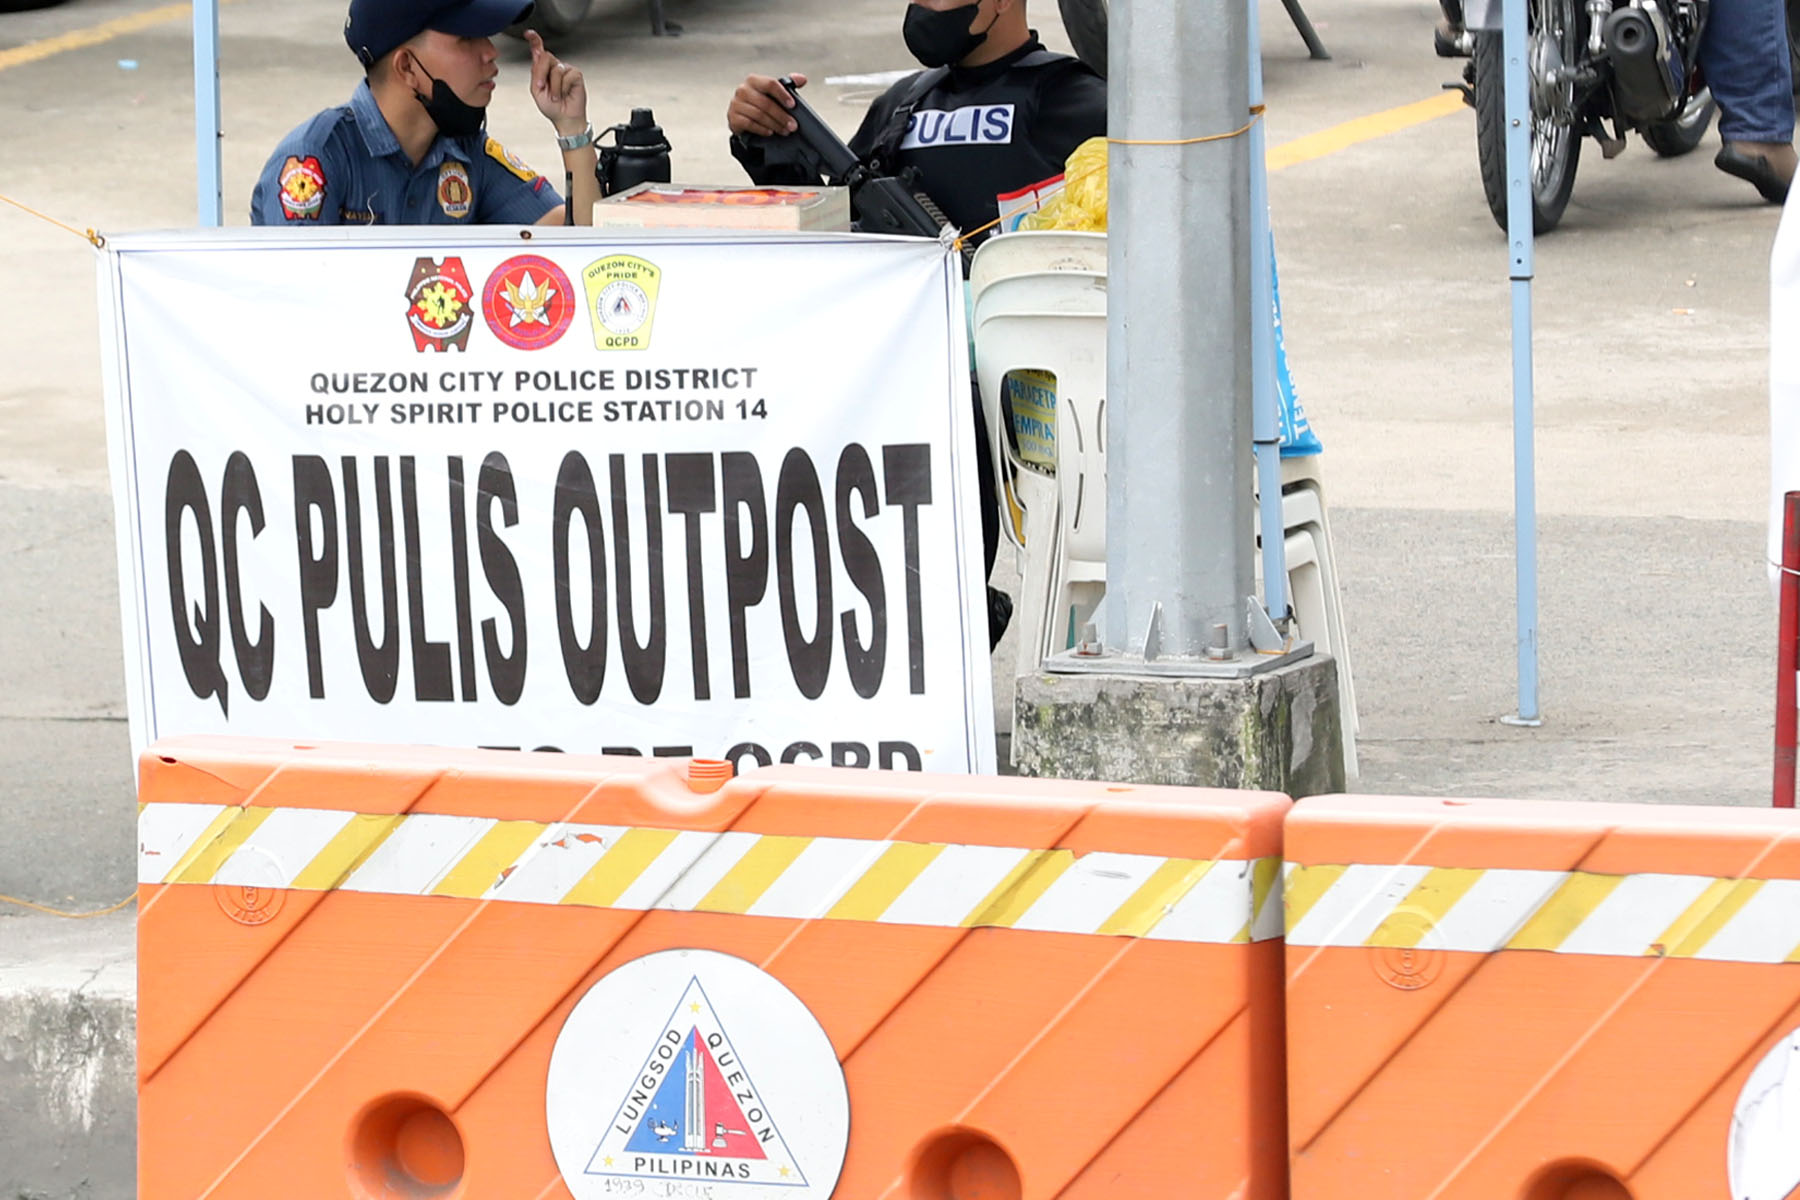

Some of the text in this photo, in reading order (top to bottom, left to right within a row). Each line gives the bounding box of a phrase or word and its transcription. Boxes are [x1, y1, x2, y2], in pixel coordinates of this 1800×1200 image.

[588, 261, 625, 279] QUEZON
[606, 271, 638, 279] PRIDE
[605, 336, 639, 347] QCPD
[310, 368, 757, 395] QUEZON CITY POLICE DISTRICT
[306, 399, 768, 425] HOLY SPIRIT POLICE STATION 14
[165, 442, 932, 720] QC PULIS OUTPOST
[615, 1028, 681, 1135] LUNGSOD
[707, 1032, 774, 1145] QUEZON
[634, 1156, 751, 1179] PILIPINAS
